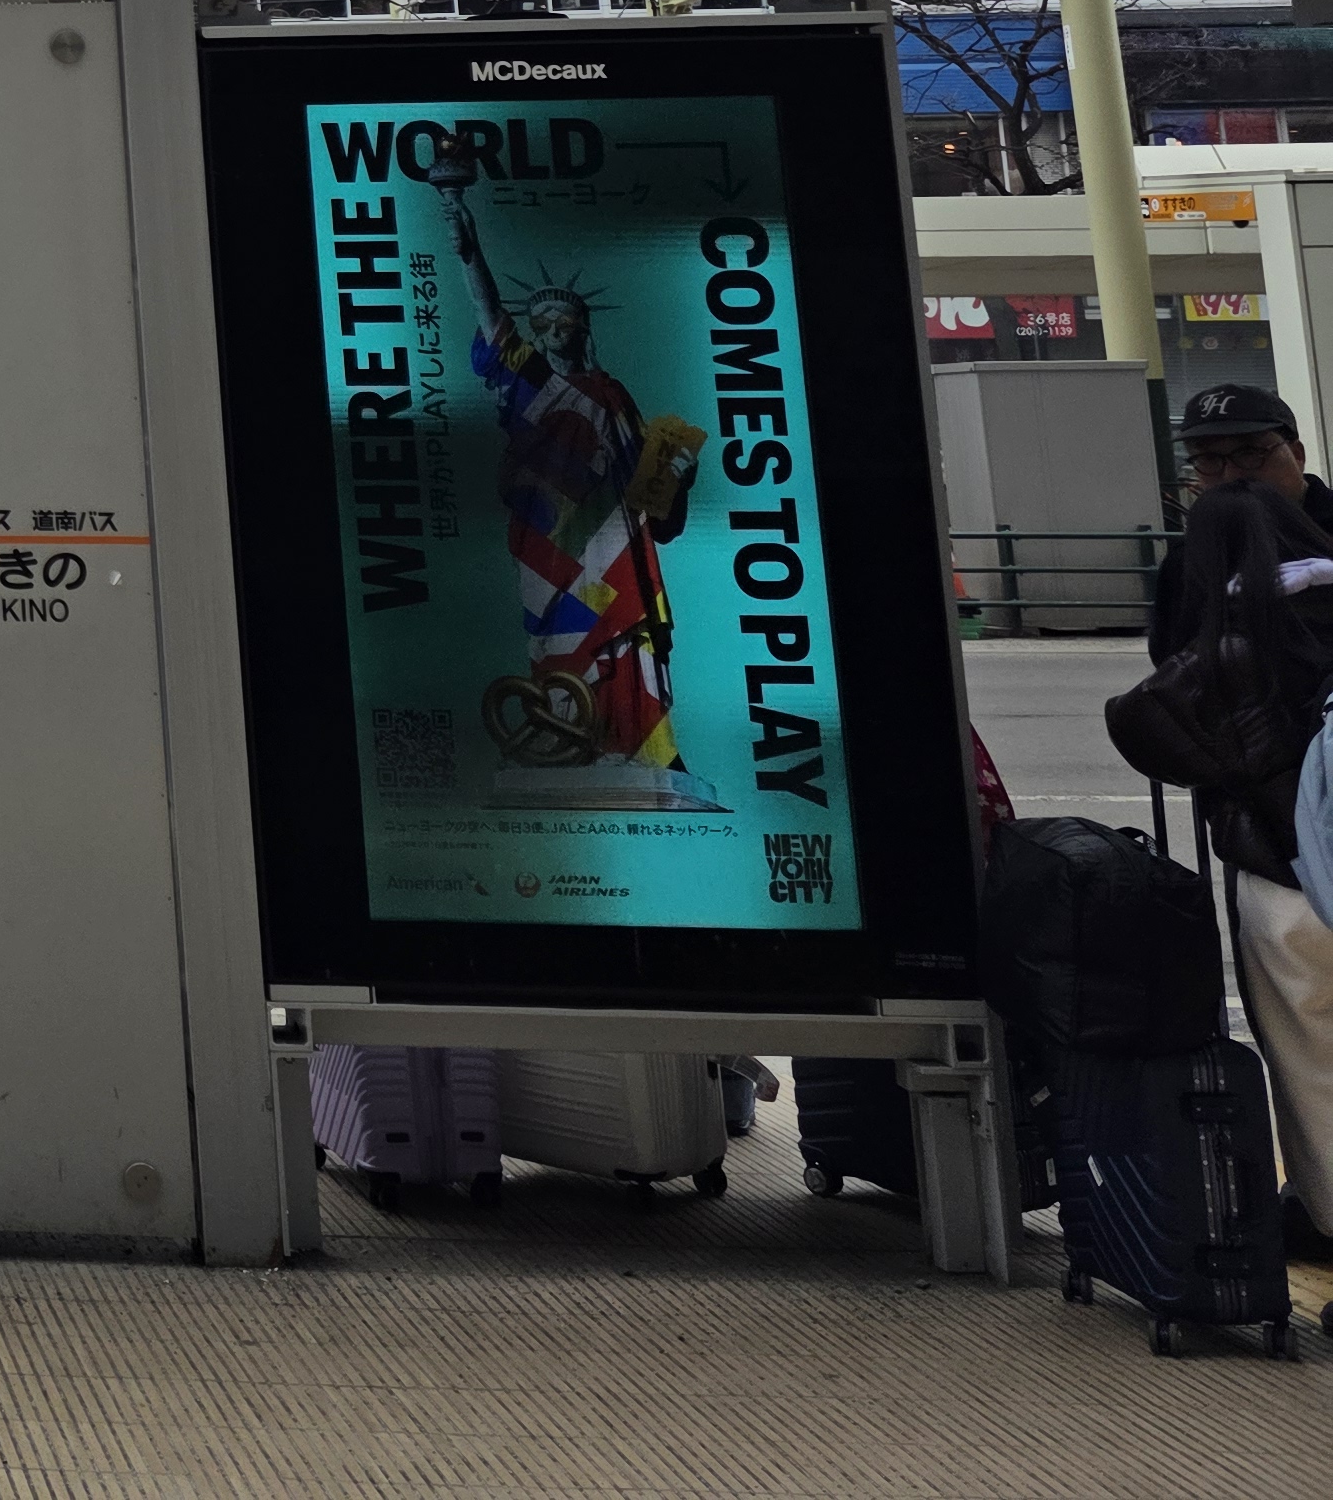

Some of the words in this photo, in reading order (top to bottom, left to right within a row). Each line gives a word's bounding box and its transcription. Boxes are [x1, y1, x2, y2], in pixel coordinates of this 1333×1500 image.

[471, 61, 607, 82] MCDecaux
[321, 117, 605, 183] WORLD
[492, 183, 650, 207] ニューヨーク
[1161, 196, 1196, 212] すすきの
[332, 195, 405, 336] THE
[1027, 312, 1071, 326] 36号店
[700, 216, 793, 488] COMES
[409, 251, 460, 542] 世界がPLAYしに来る街
[342, 346, 430, 614] WHERE
[32, 510, 118, 532] 道南バス
[728, 497, 804, 601] TO
[739, 613, 830, 810] PLAY
[763, 833, 832, 857] NEW
[548, 875, 601, 885] JAPAN
[766, 857, 833, 880] YORK
[552, 886, 630, 897] AIRLINES
[769, 880, 833, 904] CITY
